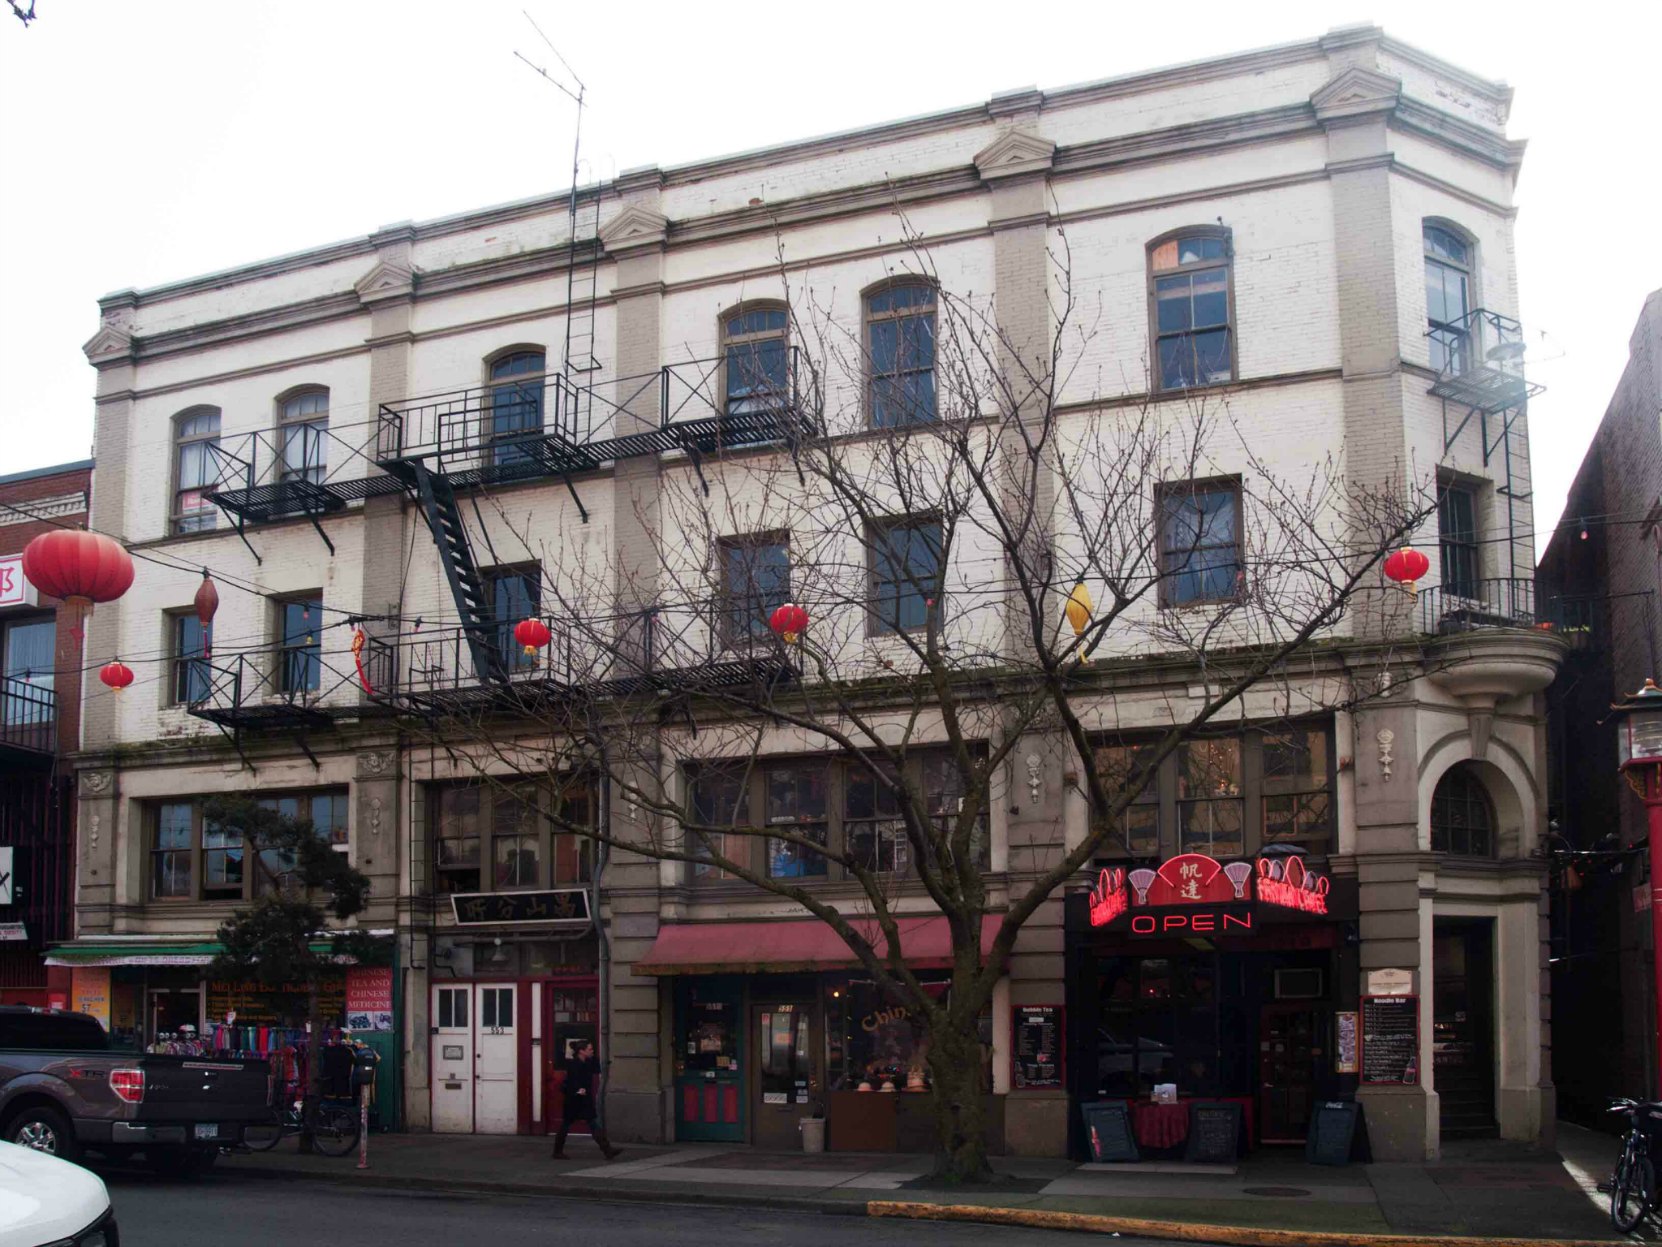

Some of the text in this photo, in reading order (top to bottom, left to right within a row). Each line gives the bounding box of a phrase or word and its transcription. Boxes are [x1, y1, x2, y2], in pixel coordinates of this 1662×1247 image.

[1131, 912, 1252, 933] OPEN
[351, 979, 391, 988] TEA AND
[350, 990, 390, 998] CHINESE
[348, 1000, 392, 1009] MEDICINE
[490, 1026, 505, 1035] 553
[68, 1070, 106, 1080] XTR
